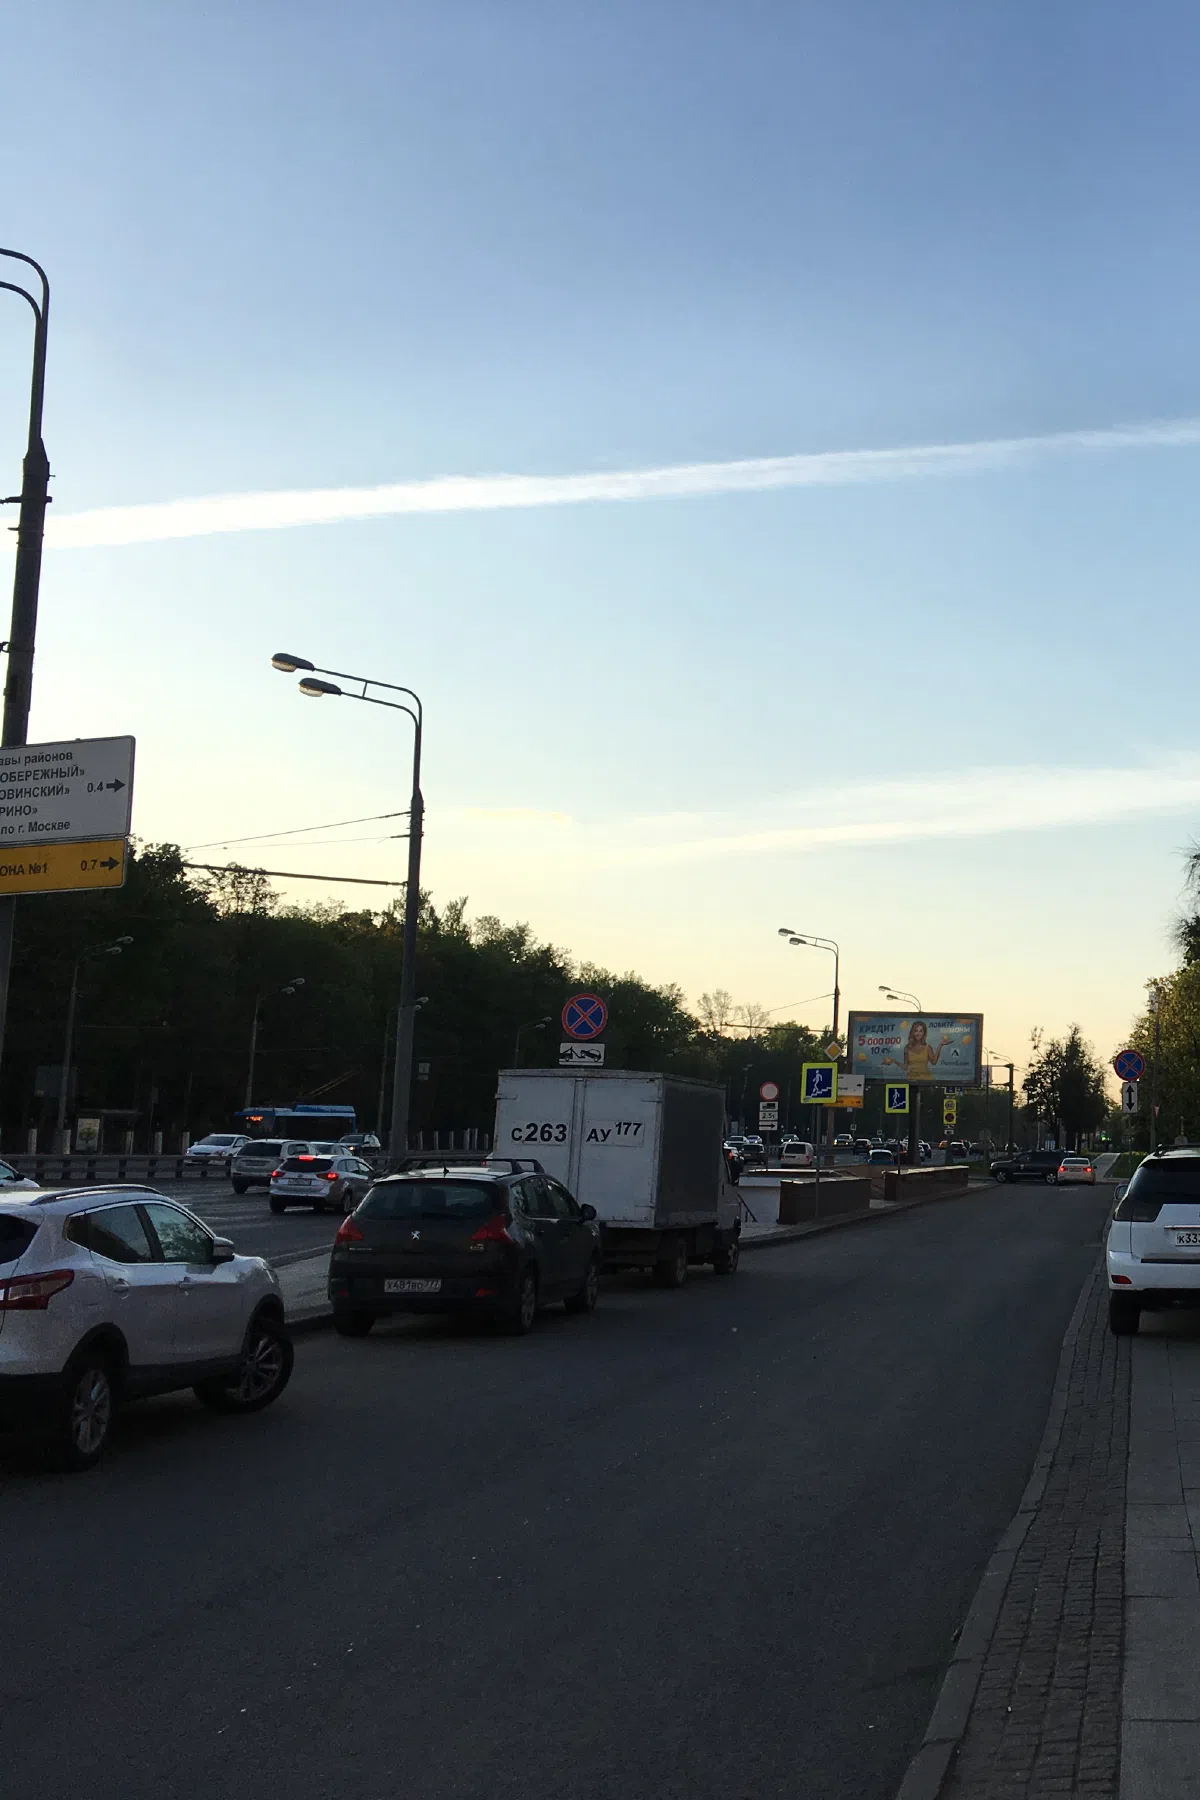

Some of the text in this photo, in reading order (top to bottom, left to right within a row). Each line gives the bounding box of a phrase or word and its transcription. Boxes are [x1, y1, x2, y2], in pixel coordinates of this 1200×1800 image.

[24, 752, 73, 766] районов
[87, 781, 104, 793] 0.4
[28, 821, 70, 832] Москве
[29, 862, 48, 874] №1
[859, 1024, 895, 1033] КРЕДИТ
[858, 1034, 902, 1046] 5 000 000
[615, 1122, 643, 1136] 177
